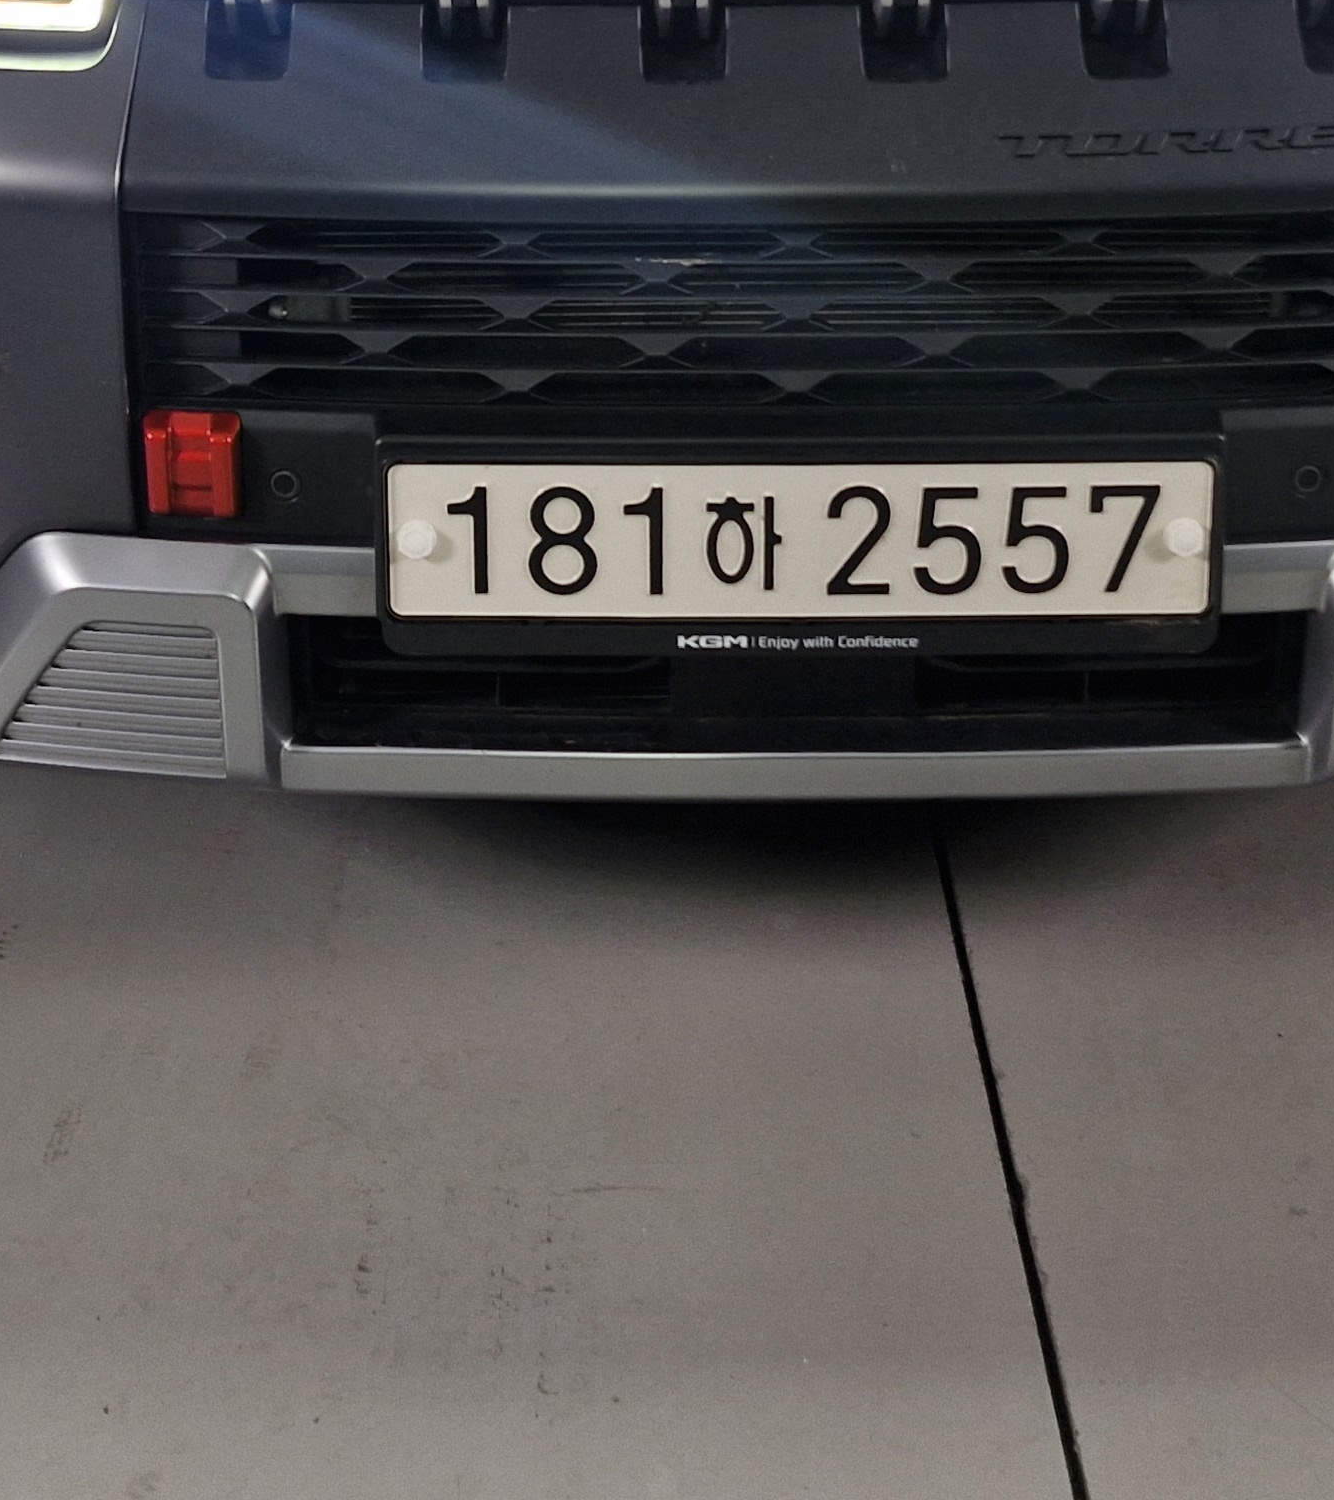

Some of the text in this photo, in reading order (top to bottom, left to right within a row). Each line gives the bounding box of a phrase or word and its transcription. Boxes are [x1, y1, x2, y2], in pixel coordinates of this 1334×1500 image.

[446, 485, 1162, 596] 181하 2557
[677, 635, 919, 650] KGM Enjoy with Confidence
